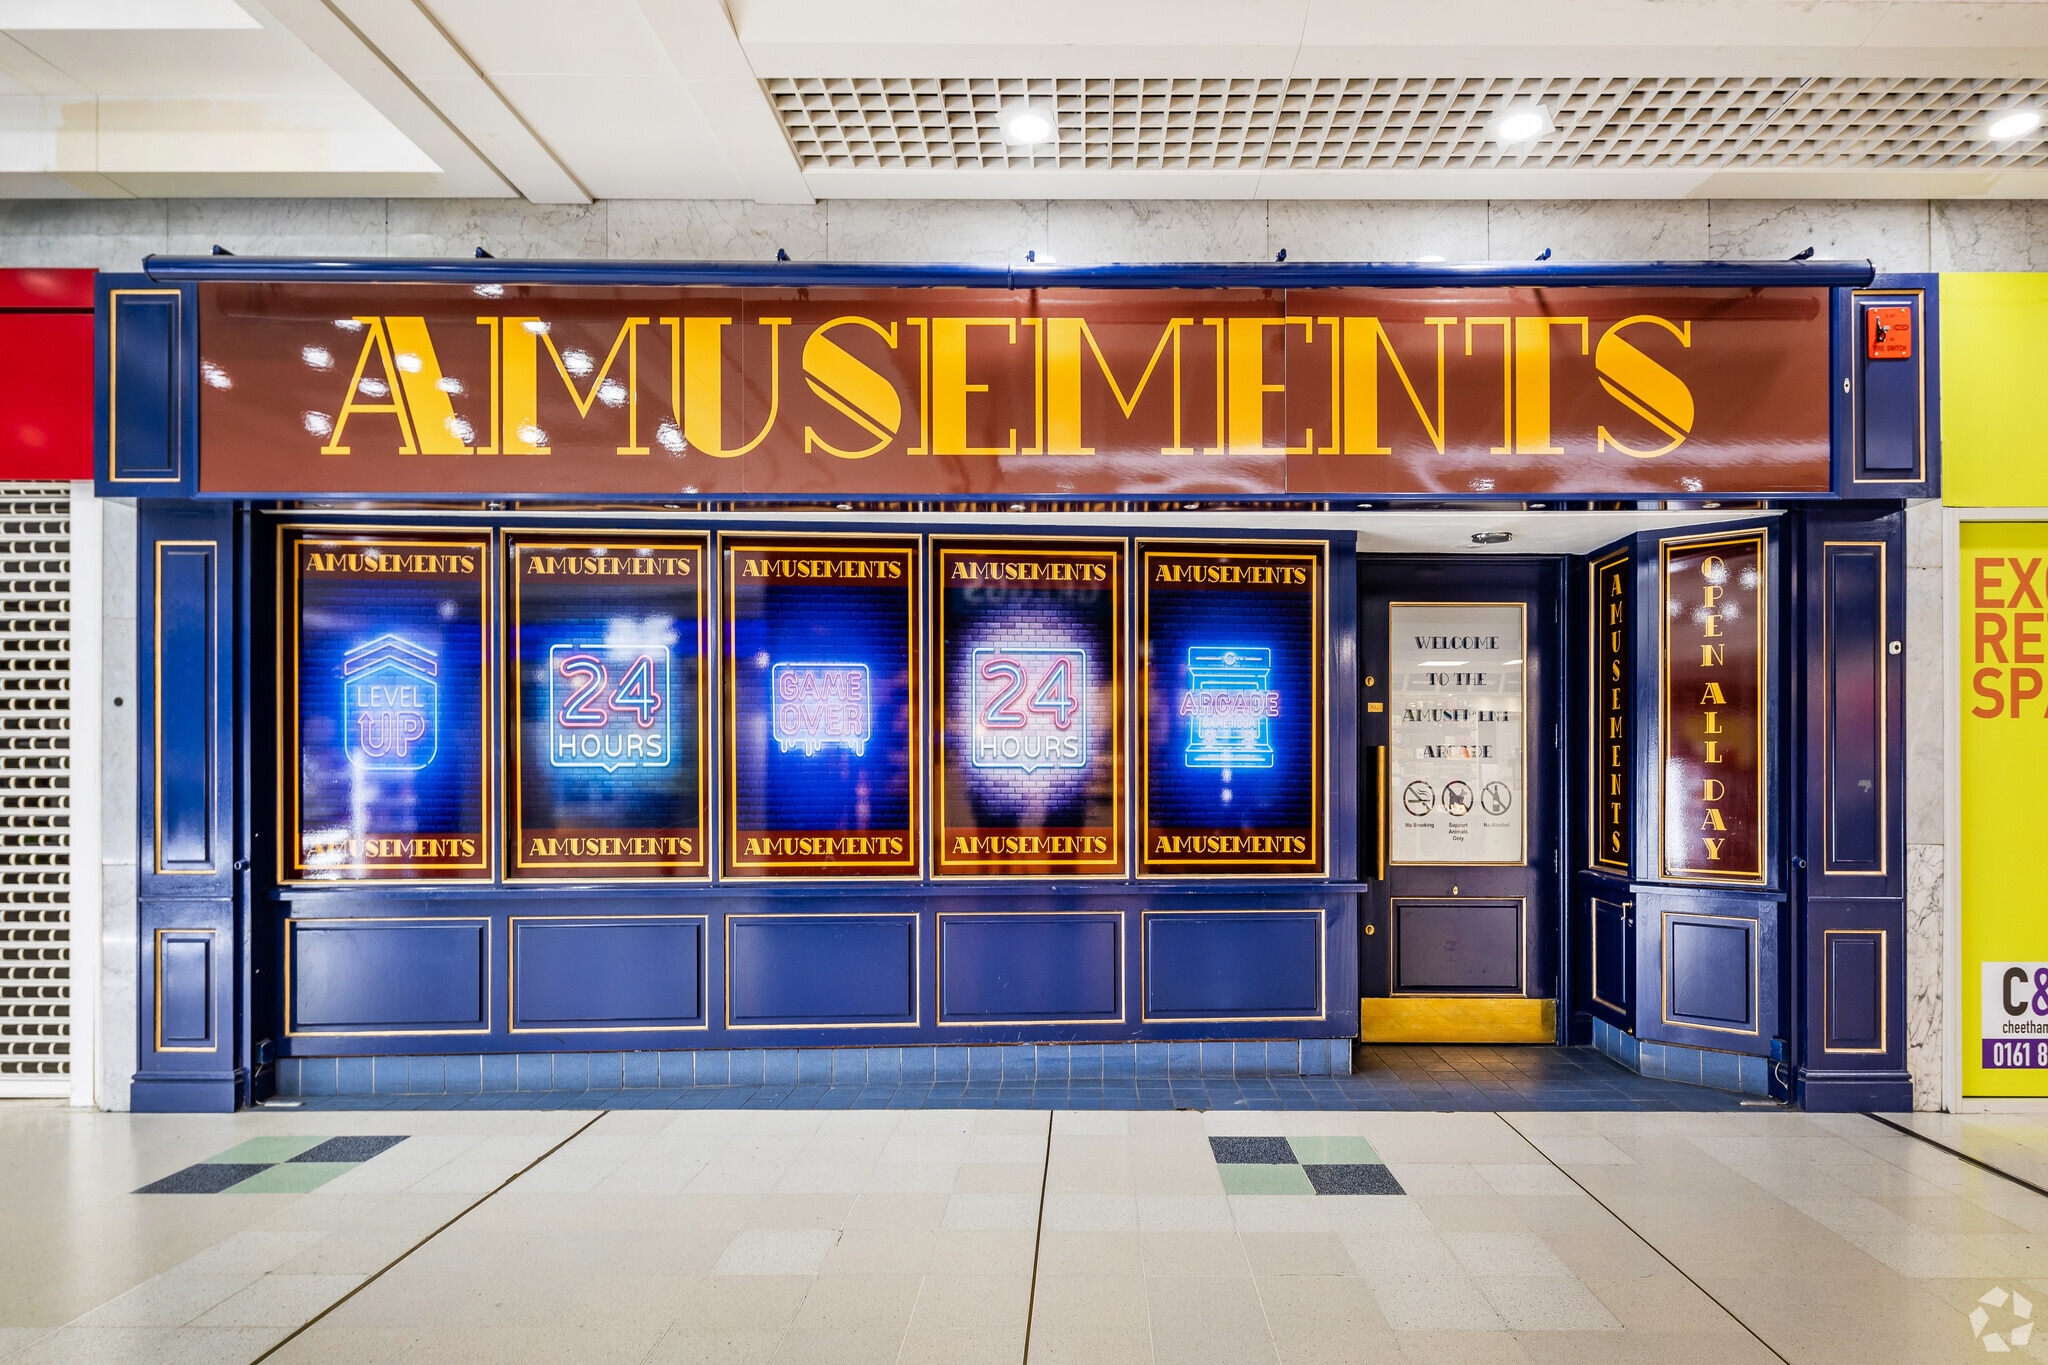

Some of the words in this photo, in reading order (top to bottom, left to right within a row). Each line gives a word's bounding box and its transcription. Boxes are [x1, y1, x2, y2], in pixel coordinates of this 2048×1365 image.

[320, 315, 1694, 459] AMUSEMENTS
[306, 553, 475, 573] AMUSEMENTS
[527, 556, 690, 576] AMUSEMENTS
[742, 559, 901, 579] AMUSEMENTS
[951, 561, 1106, 582] AMUSEMENTS
[1155, 564, 1306, 585] AMUSEMENTS
[1975, 557, 2048, 609] EX
[1701, 556, 1725, 667] OPEN
[1415, 636, 1499, 650] WELCOME
[1975, 612, 2048, 663] RE
[780, 671, 863, 701] GAME
[1426, 672, 1450, 686] TO
[1453, 672, 1487, 686] THE
[357, 686, 424, 708] LEVEL
[559, 655, 661, 728] 24
[981, 658, 1078, 729] 24
[1971, 667, 2048, 719] SP
[1179, 691, 1280, 718] ARCADE
[1610, 573, 1623, 853] AMUSEMENTS
[780, 703, 864, 735] OVER
[1700, 682, 1727, 763] ALL
[357, 711, 425, 757] UP
[558, 734, 662, 757] HOURS
[980, 736, 1079, 759] HOURS
[1423, 744, 1493, 759] ARCADE
[1701, 779, 1727, 860] DAY
[529, 838, 692, 856] AMUSEMENTS
[744, 837, 903, 856] AMUSEMENTS
[952, 836, 1107, 855] AMUSEMENTS
[1155, 836, 1307, 855] AMUSEMENTS
[1993, 1042, 2030, 1067] 0161
